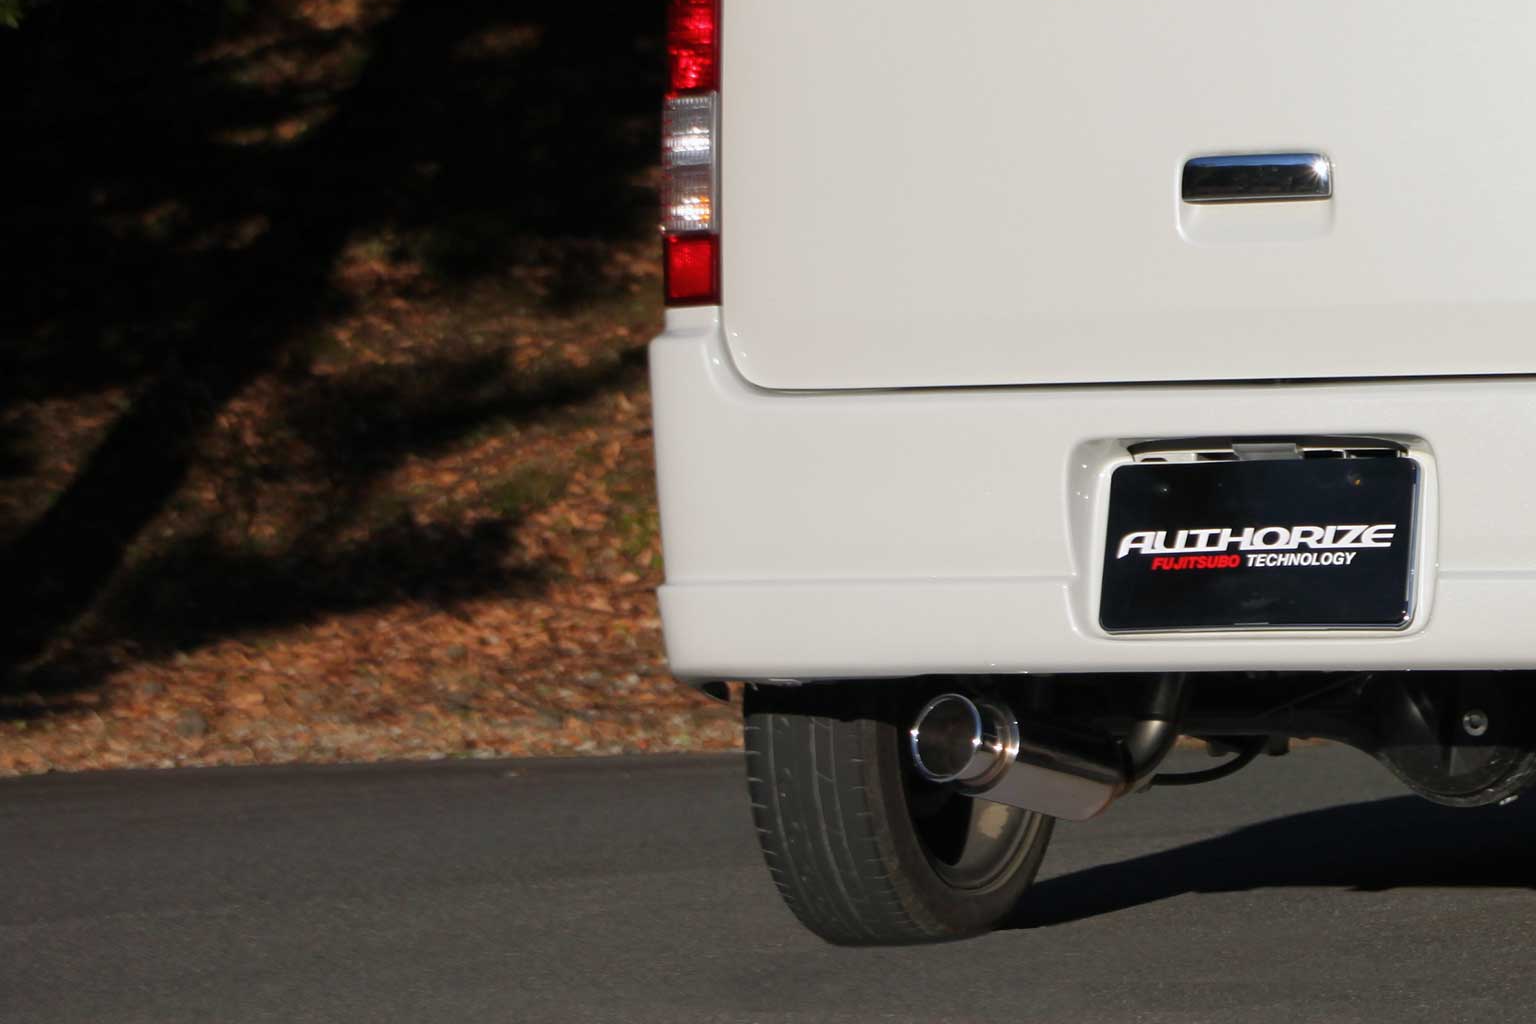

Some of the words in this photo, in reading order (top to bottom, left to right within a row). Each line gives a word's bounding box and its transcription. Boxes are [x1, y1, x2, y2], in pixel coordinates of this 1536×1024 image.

[1117, 524, 1396, 559] AUTHORIZE
[1152, 554, 1241, 570] FUJITSUBO
[1246, 552, 1356, 567] TECHNOLOGY
